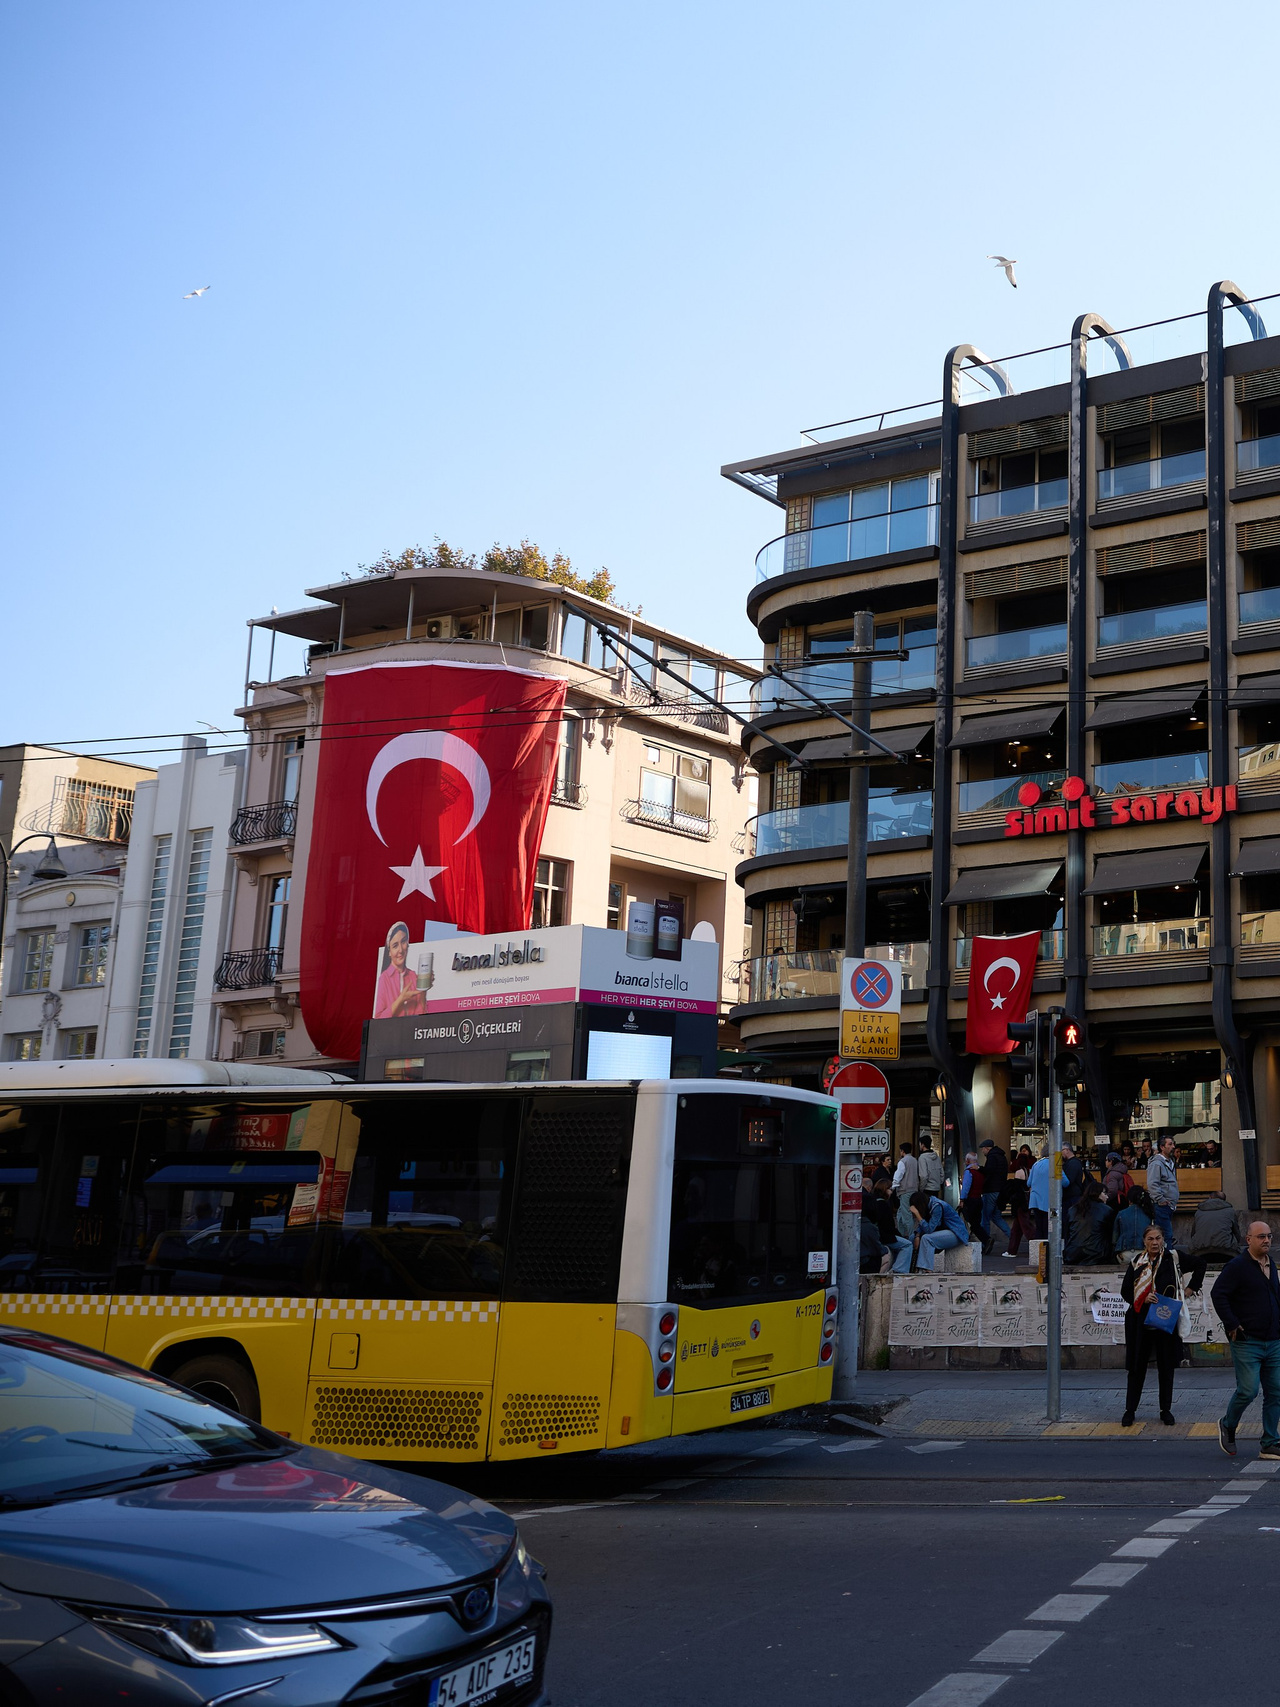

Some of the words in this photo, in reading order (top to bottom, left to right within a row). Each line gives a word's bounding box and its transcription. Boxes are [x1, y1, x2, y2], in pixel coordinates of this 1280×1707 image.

[1004, 775, 1097, 837] simit
[1111, 784, 1239, 825] sarayı
[457, 1000, 471, 1008] HER
[489, 997, 504, 1005] HER
[521, 993, 540, 1003] BOYA
[601, 993, 619, 1003] HER
[619, 995, 638, 1005] YERİ
[639, 998, 657, 1007] HER
[658, 998, 676, 1009] ŞEYİ
[677, 1001, 698, 1010] BOYA
[858, 1013, 884, 1023] İETT
[414, 1026, 457, 1040] İSTANBUL
[475, 1019, 521, 1038] ÇİÇEKLERİ
[851, 1024, 890, 1034] DURAK
[853, 1035, 888, 1044] ALANI
[844, 1044, 897, 1056] BAŞLANGICI
[840, 1137, 853, 1146] TT
[857, 1135, 887, 1147] HARİÇ
[795, 1303, 821, 1318] K-1732
[961, 1315, 978, 1328] Fil
[1005, 1315, 1022, 1329] Fil
[690, 1343, 707, 1354] İETT
[731, 1397, 741, 1410] 34
[741, 1395, 752, 1409] TP
[752, 1389, 770, 1406] 8873
[438, 1675, 457, 1707] 54
[466, 1657, 496, 1697] ADF
[503, 1640, 533, 1679] 235
